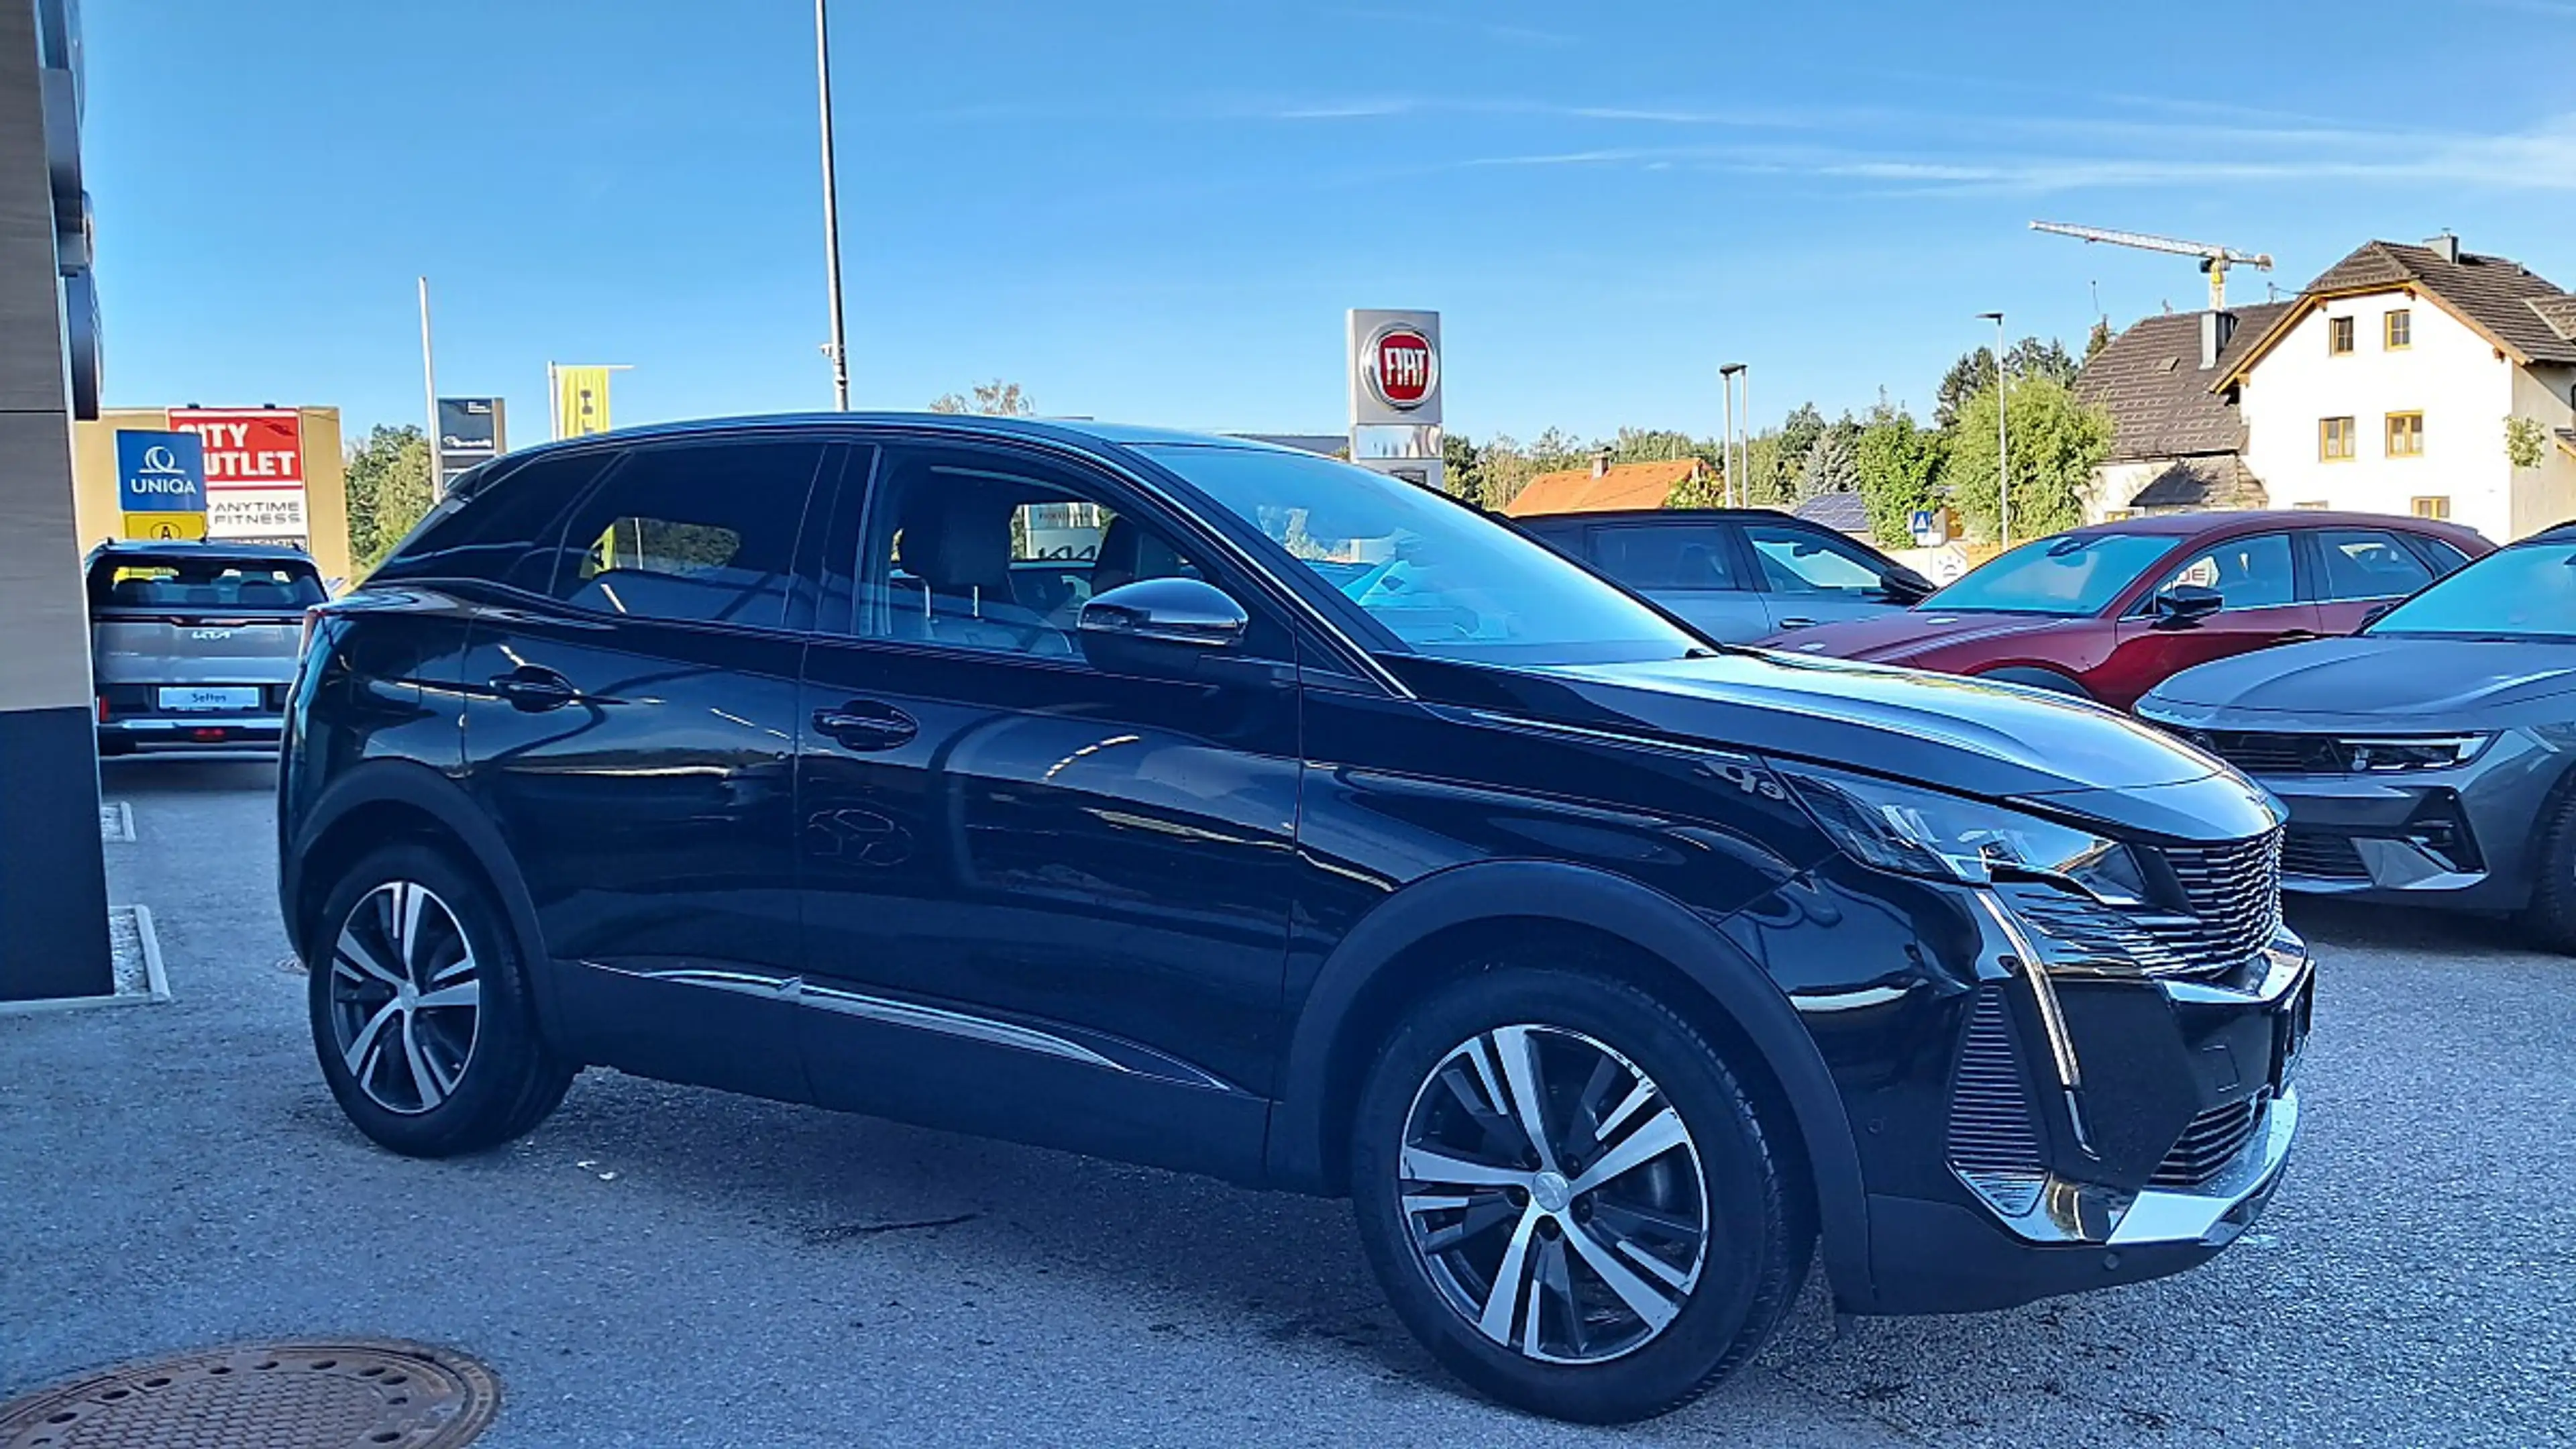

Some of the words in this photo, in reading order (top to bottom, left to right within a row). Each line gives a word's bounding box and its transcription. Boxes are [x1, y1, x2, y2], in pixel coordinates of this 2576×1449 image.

[1385, 347, 1426, 386] FIAT
[130, 478, 197, 494] UNIQA
[214, 502, 299, 513] ANYTIME
[214, 513, 301, 525] FITNESS
